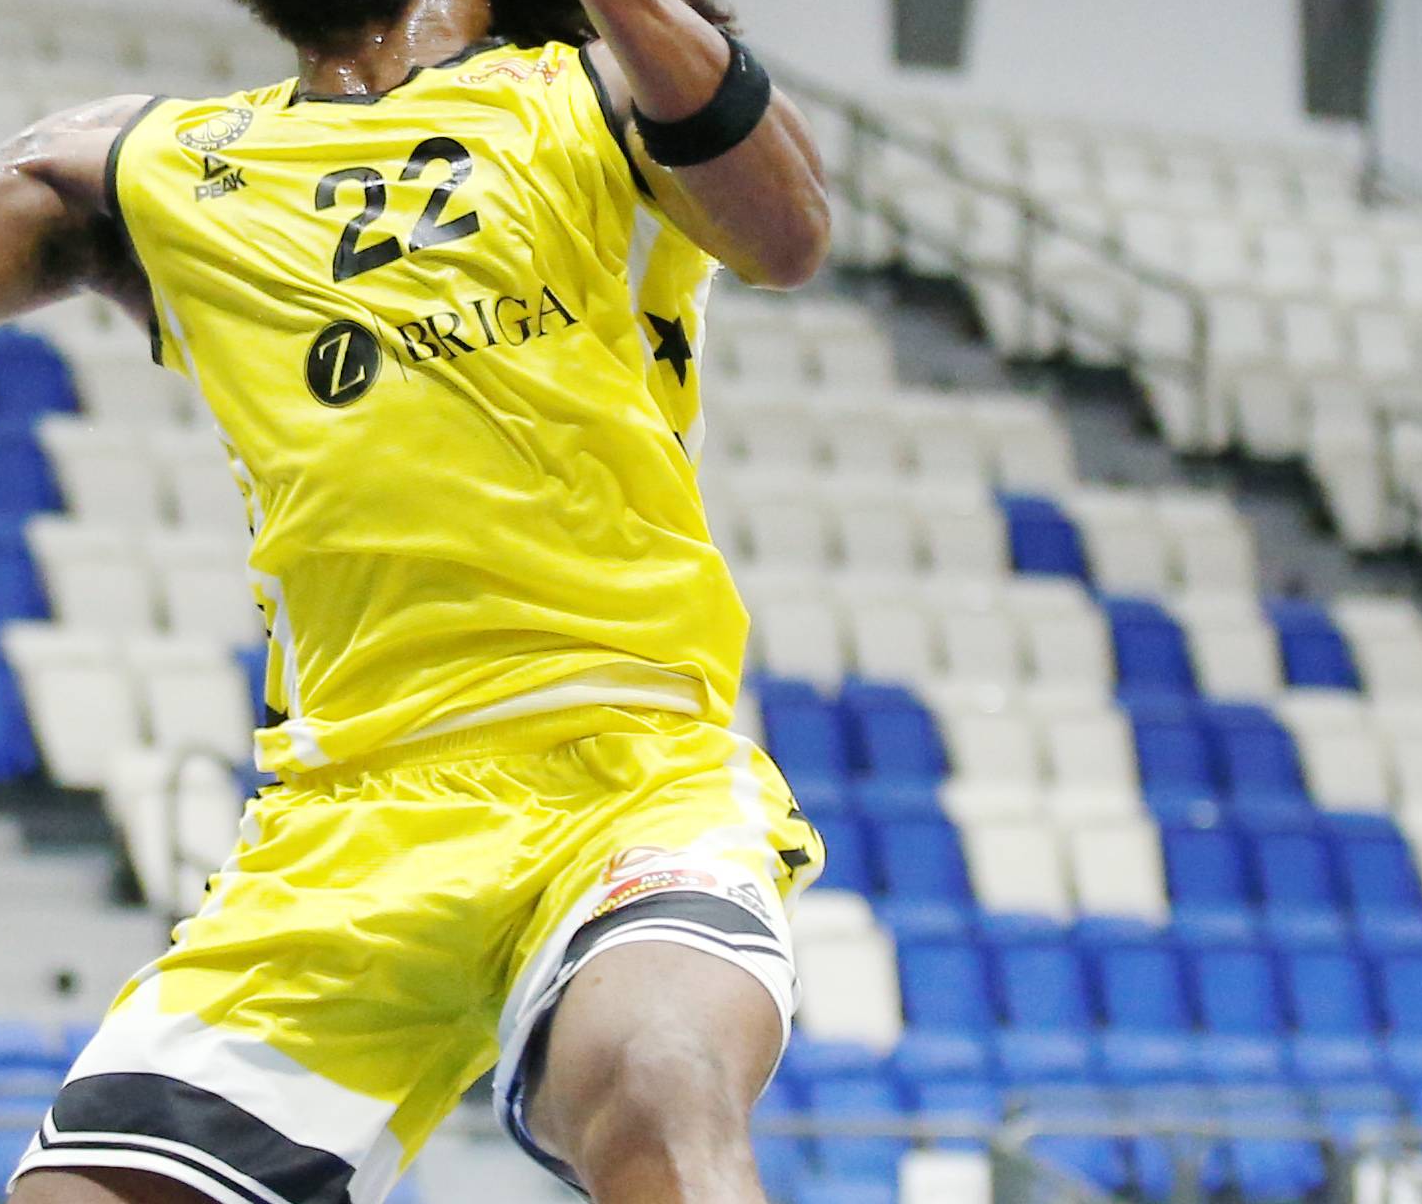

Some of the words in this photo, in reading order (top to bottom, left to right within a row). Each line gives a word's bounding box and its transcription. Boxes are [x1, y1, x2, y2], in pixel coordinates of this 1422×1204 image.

[194, 167, 248, 203] PEAK
[314, 136, 481, 282] 22
[396, 285, 579, 364] BRIGA
